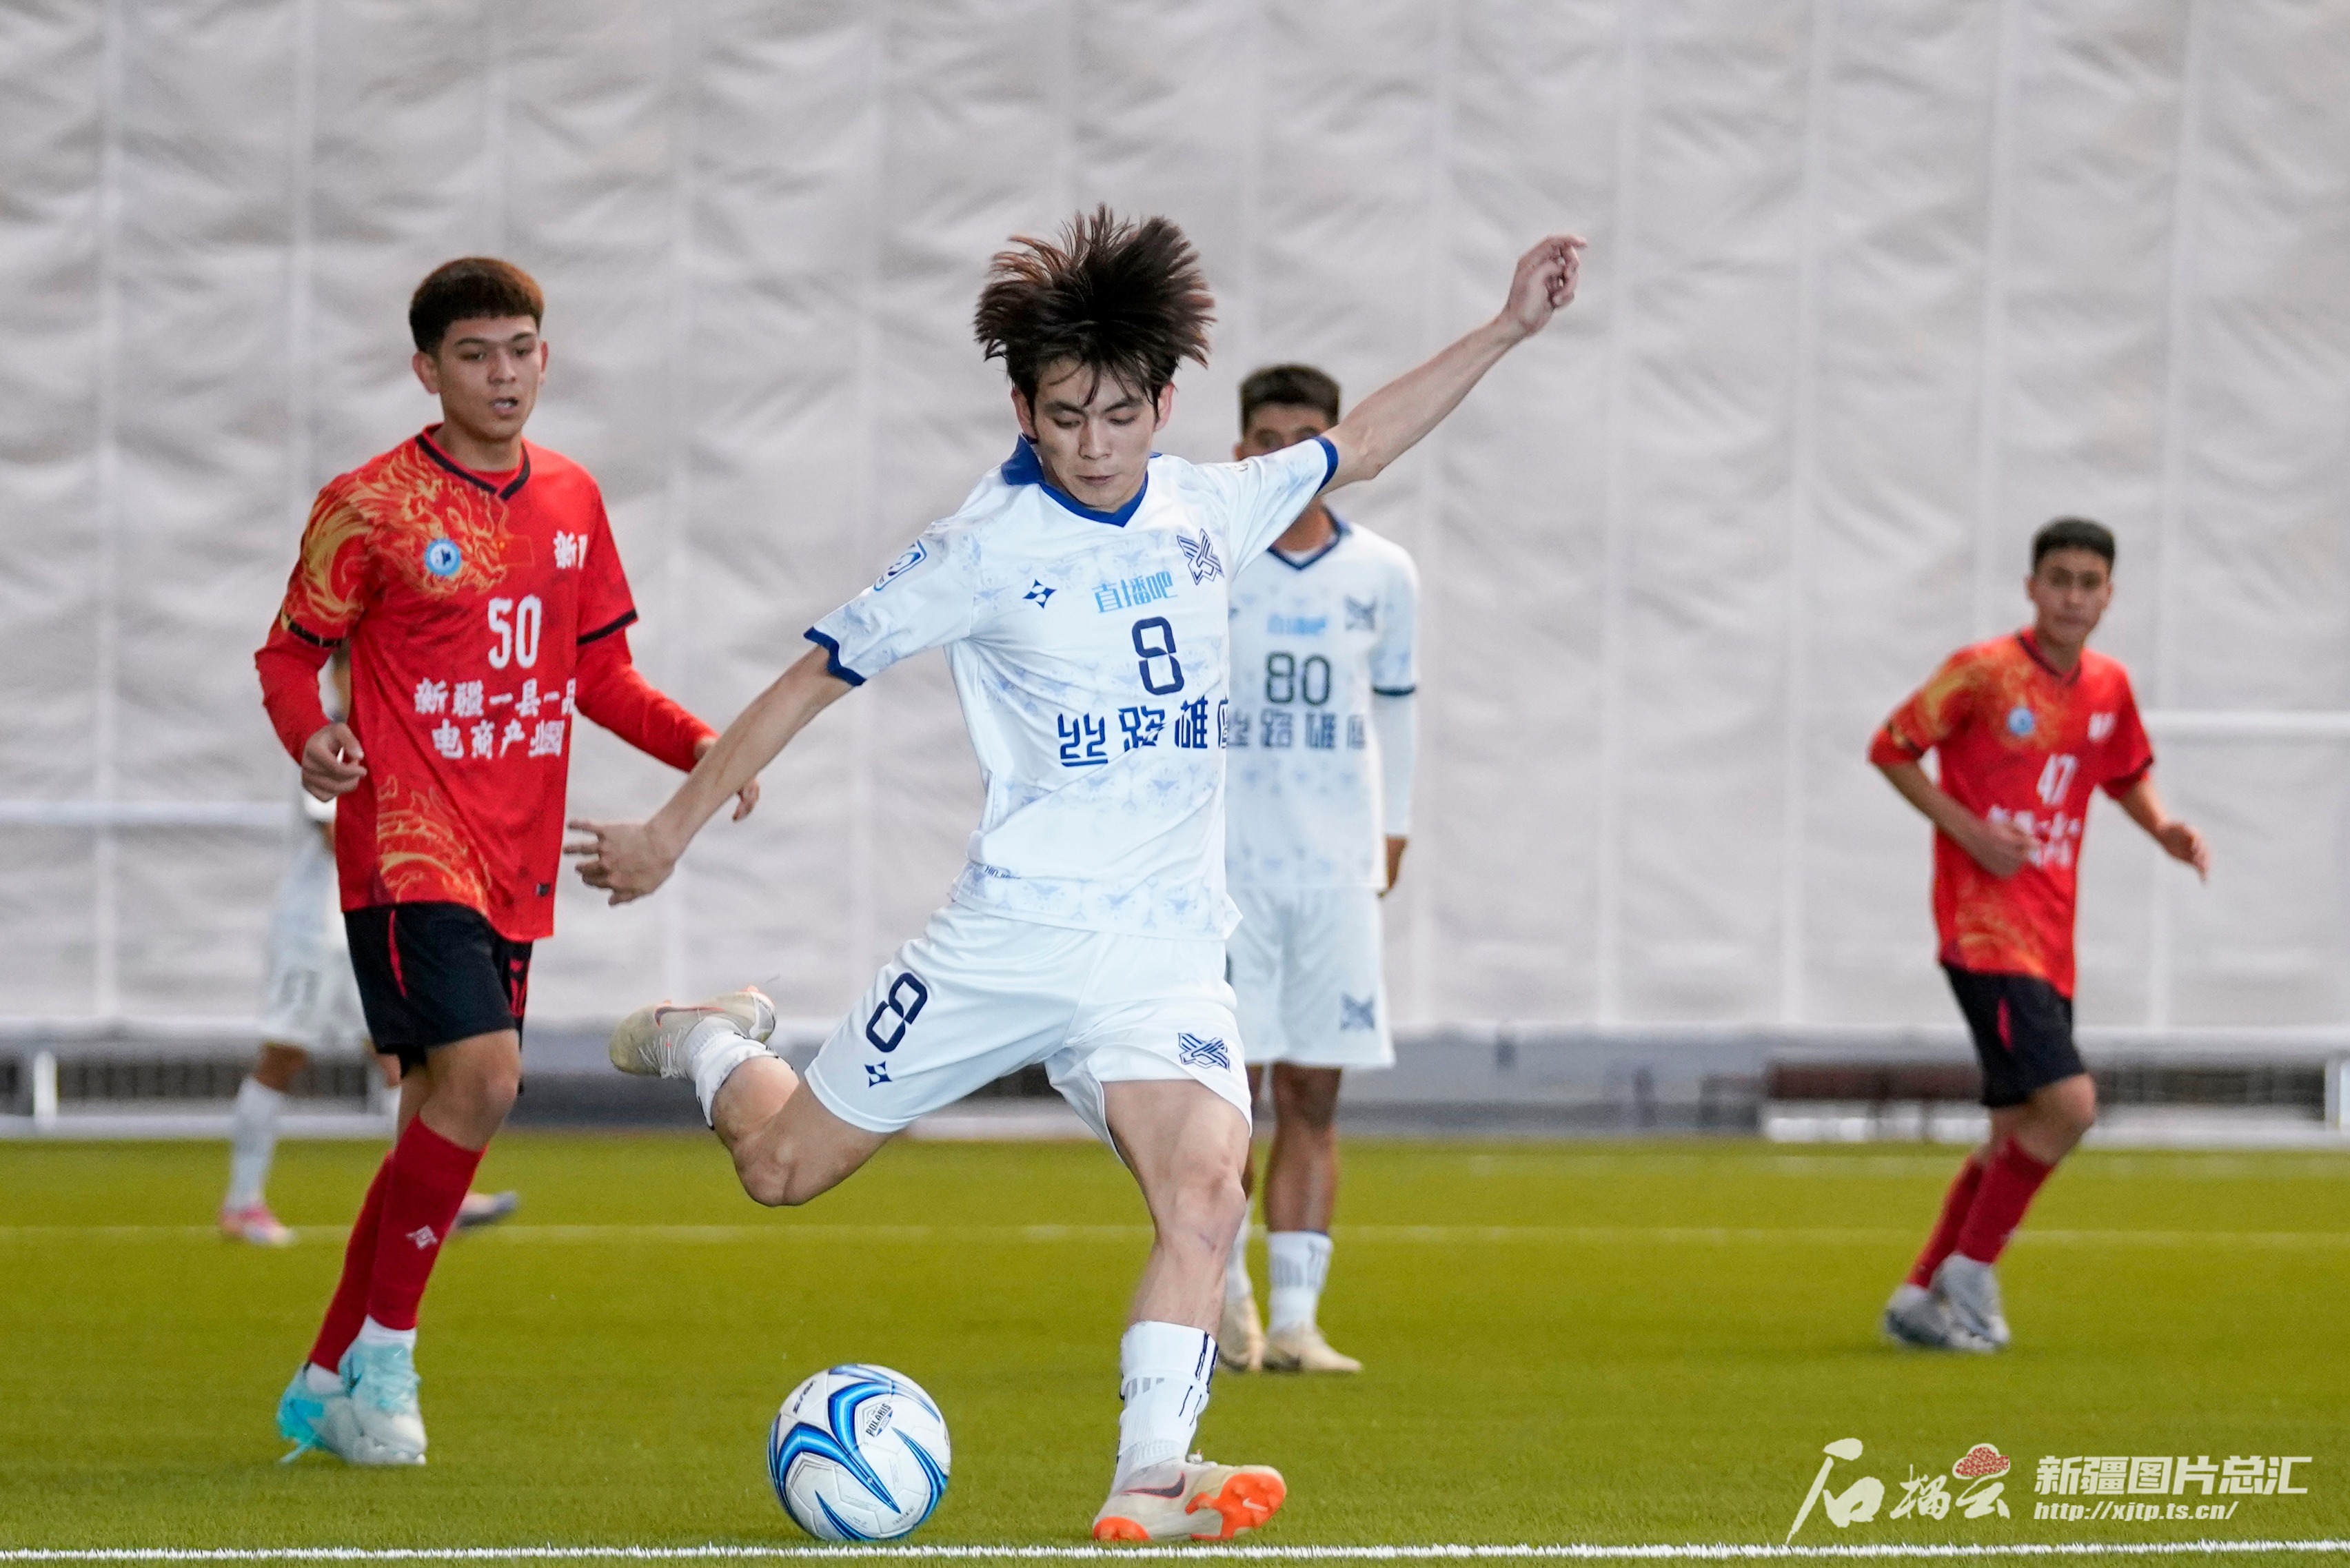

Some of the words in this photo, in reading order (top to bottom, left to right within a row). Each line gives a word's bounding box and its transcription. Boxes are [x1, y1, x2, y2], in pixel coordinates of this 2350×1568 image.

[553, 529, 588, 570] 新
[1092, 571, 1178, 613] 直播吧
[488, 595, 542, 669] 50
[1132, 616, 1184, 695] 8
[1266, 652, 1330, 706] 80
[2037, 754, 2078, 806] 47
[866, 973, 927, 1052] 8
[866, 1403, 891, 1437] POLARIS
